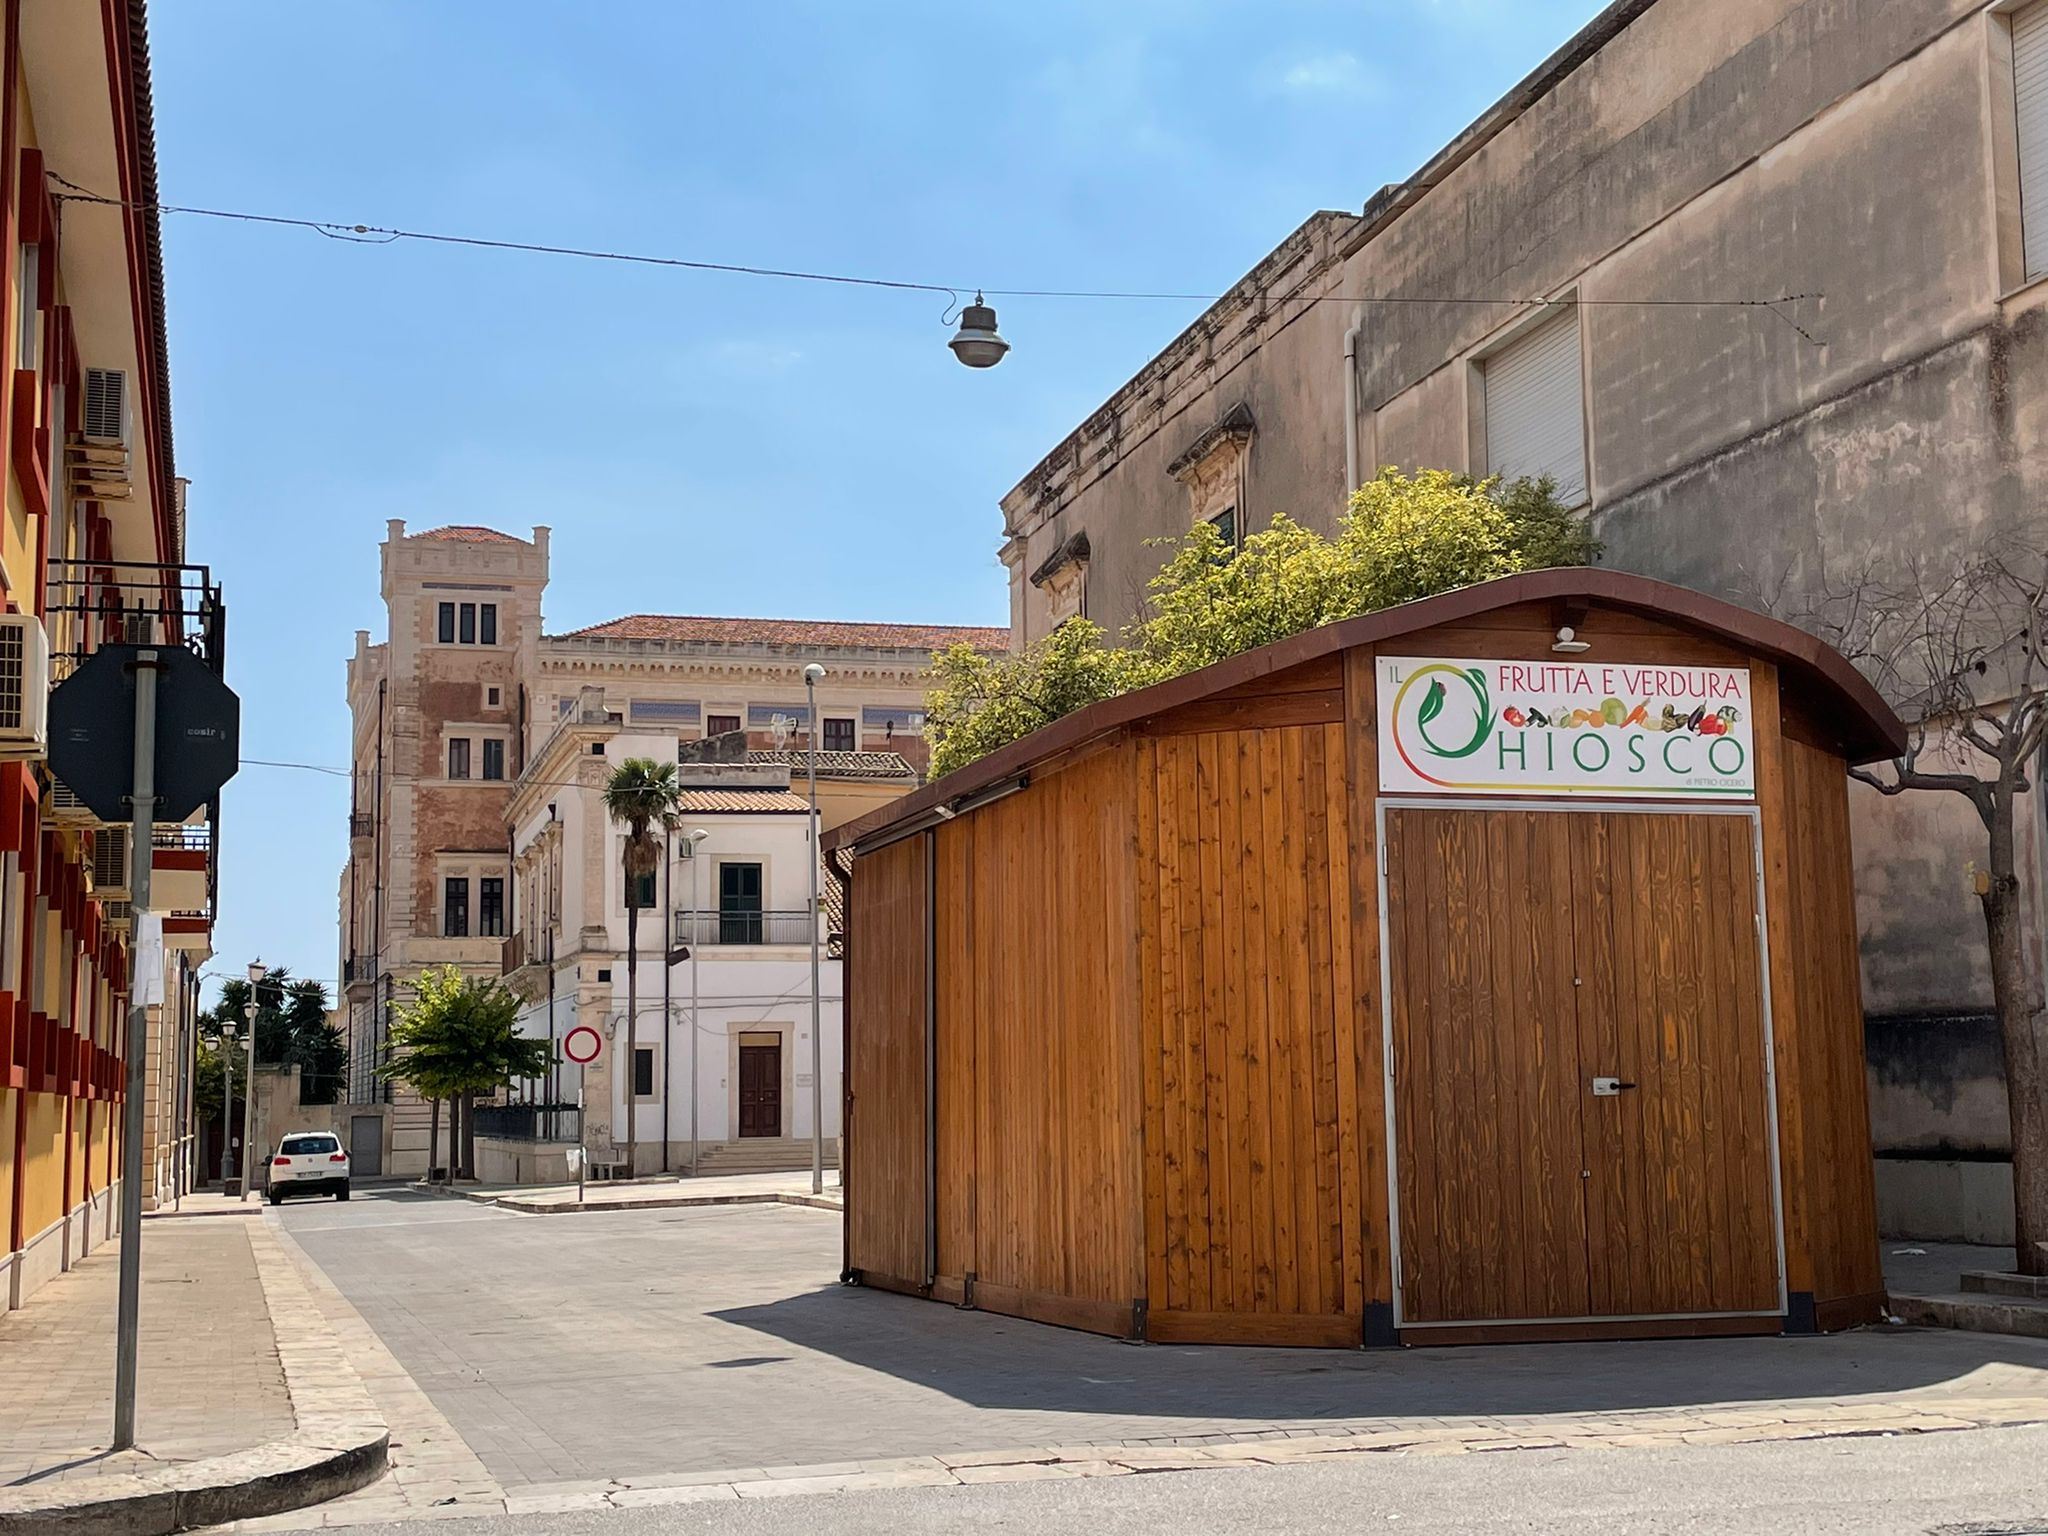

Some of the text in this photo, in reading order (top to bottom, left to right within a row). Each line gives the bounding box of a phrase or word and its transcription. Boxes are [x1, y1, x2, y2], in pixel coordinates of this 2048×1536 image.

[1389, 666, 1403, 683] IL
[1499, 665, 1742, 699] FRUTTA E VERDURA
